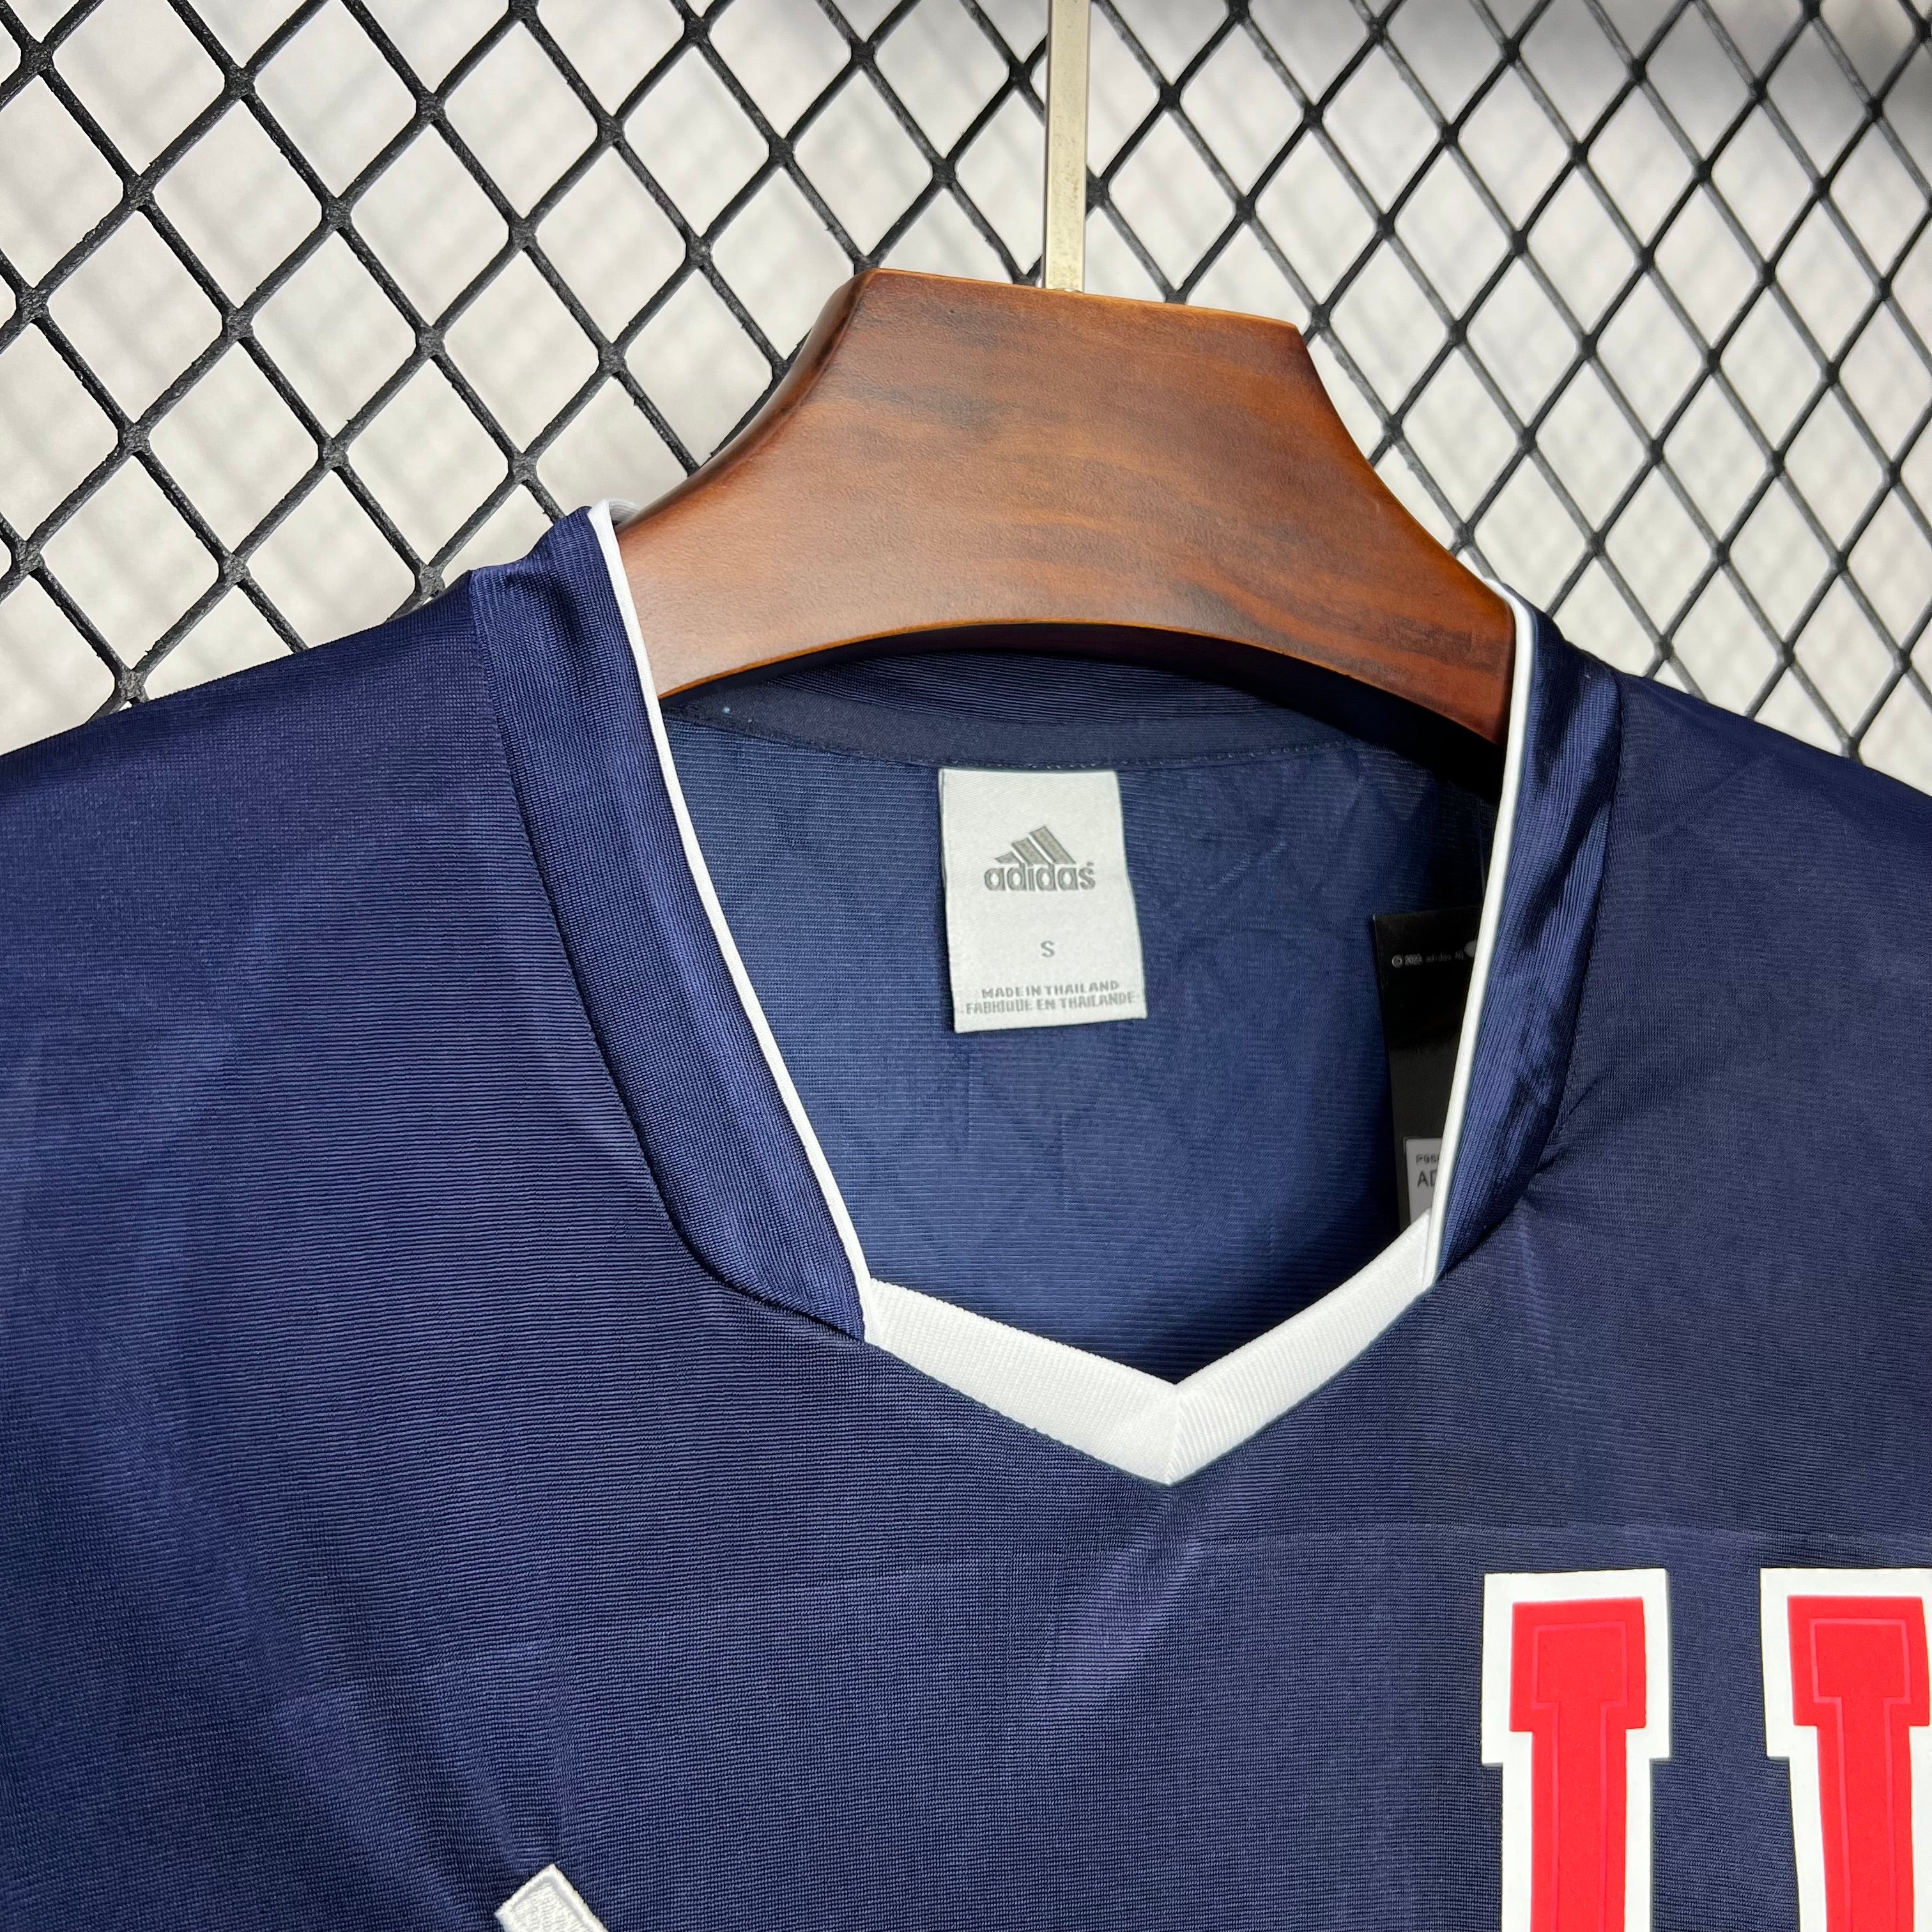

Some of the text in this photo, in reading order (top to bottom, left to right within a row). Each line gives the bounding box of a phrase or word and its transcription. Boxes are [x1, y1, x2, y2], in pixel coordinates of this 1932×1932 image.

[985, 862, 1096, 891] adidas
[1040, 940, 1055, 958] S
[981, 980, 1119, 999] MADE IN THAILAND
[1036, 999, 1055, 1011] EN
[1059, 992, 1135, 1009] THAILANDE
